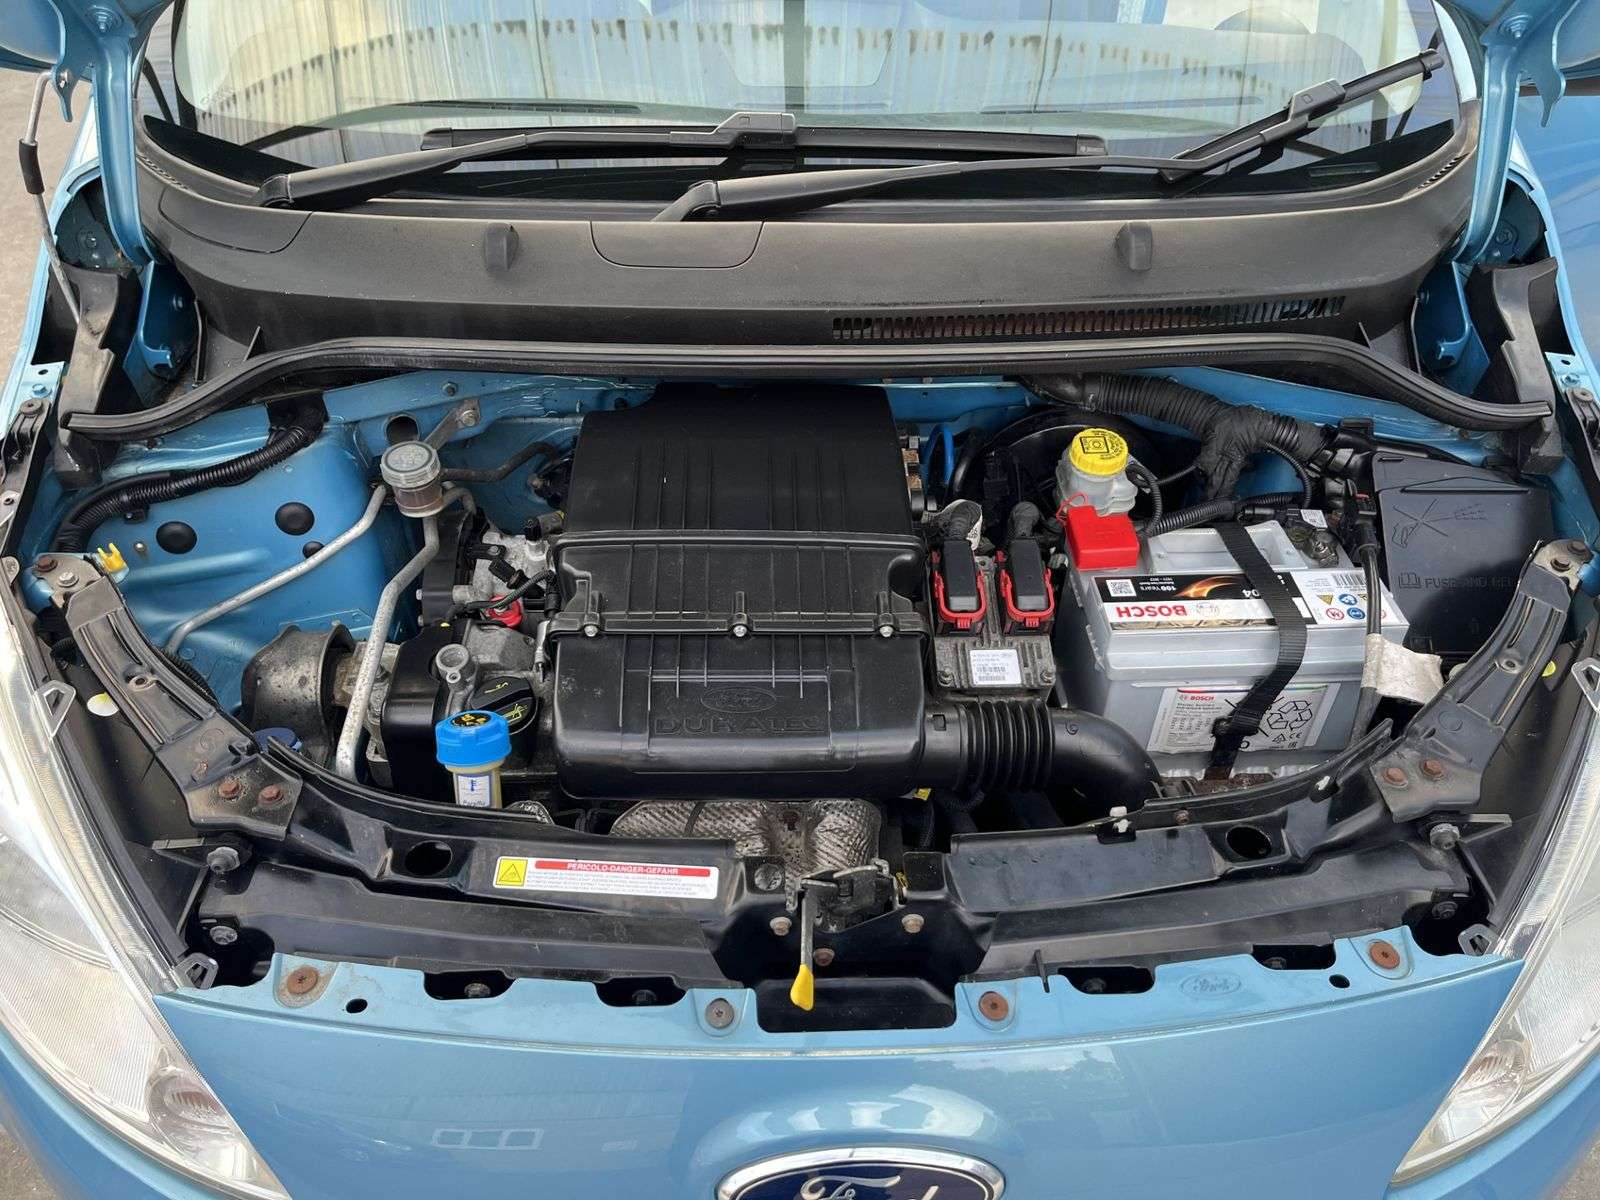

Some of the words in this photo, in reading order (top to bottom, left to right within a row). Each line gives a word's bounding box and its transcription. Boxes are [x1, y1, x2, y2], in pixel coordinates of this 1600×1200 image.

[1115, 604, 1188, 618] BOSCH
[655, 715, 825, 735] DURATEC
[567, 861, 679, 875] PERICOLO-DANGER-GEFAHR
